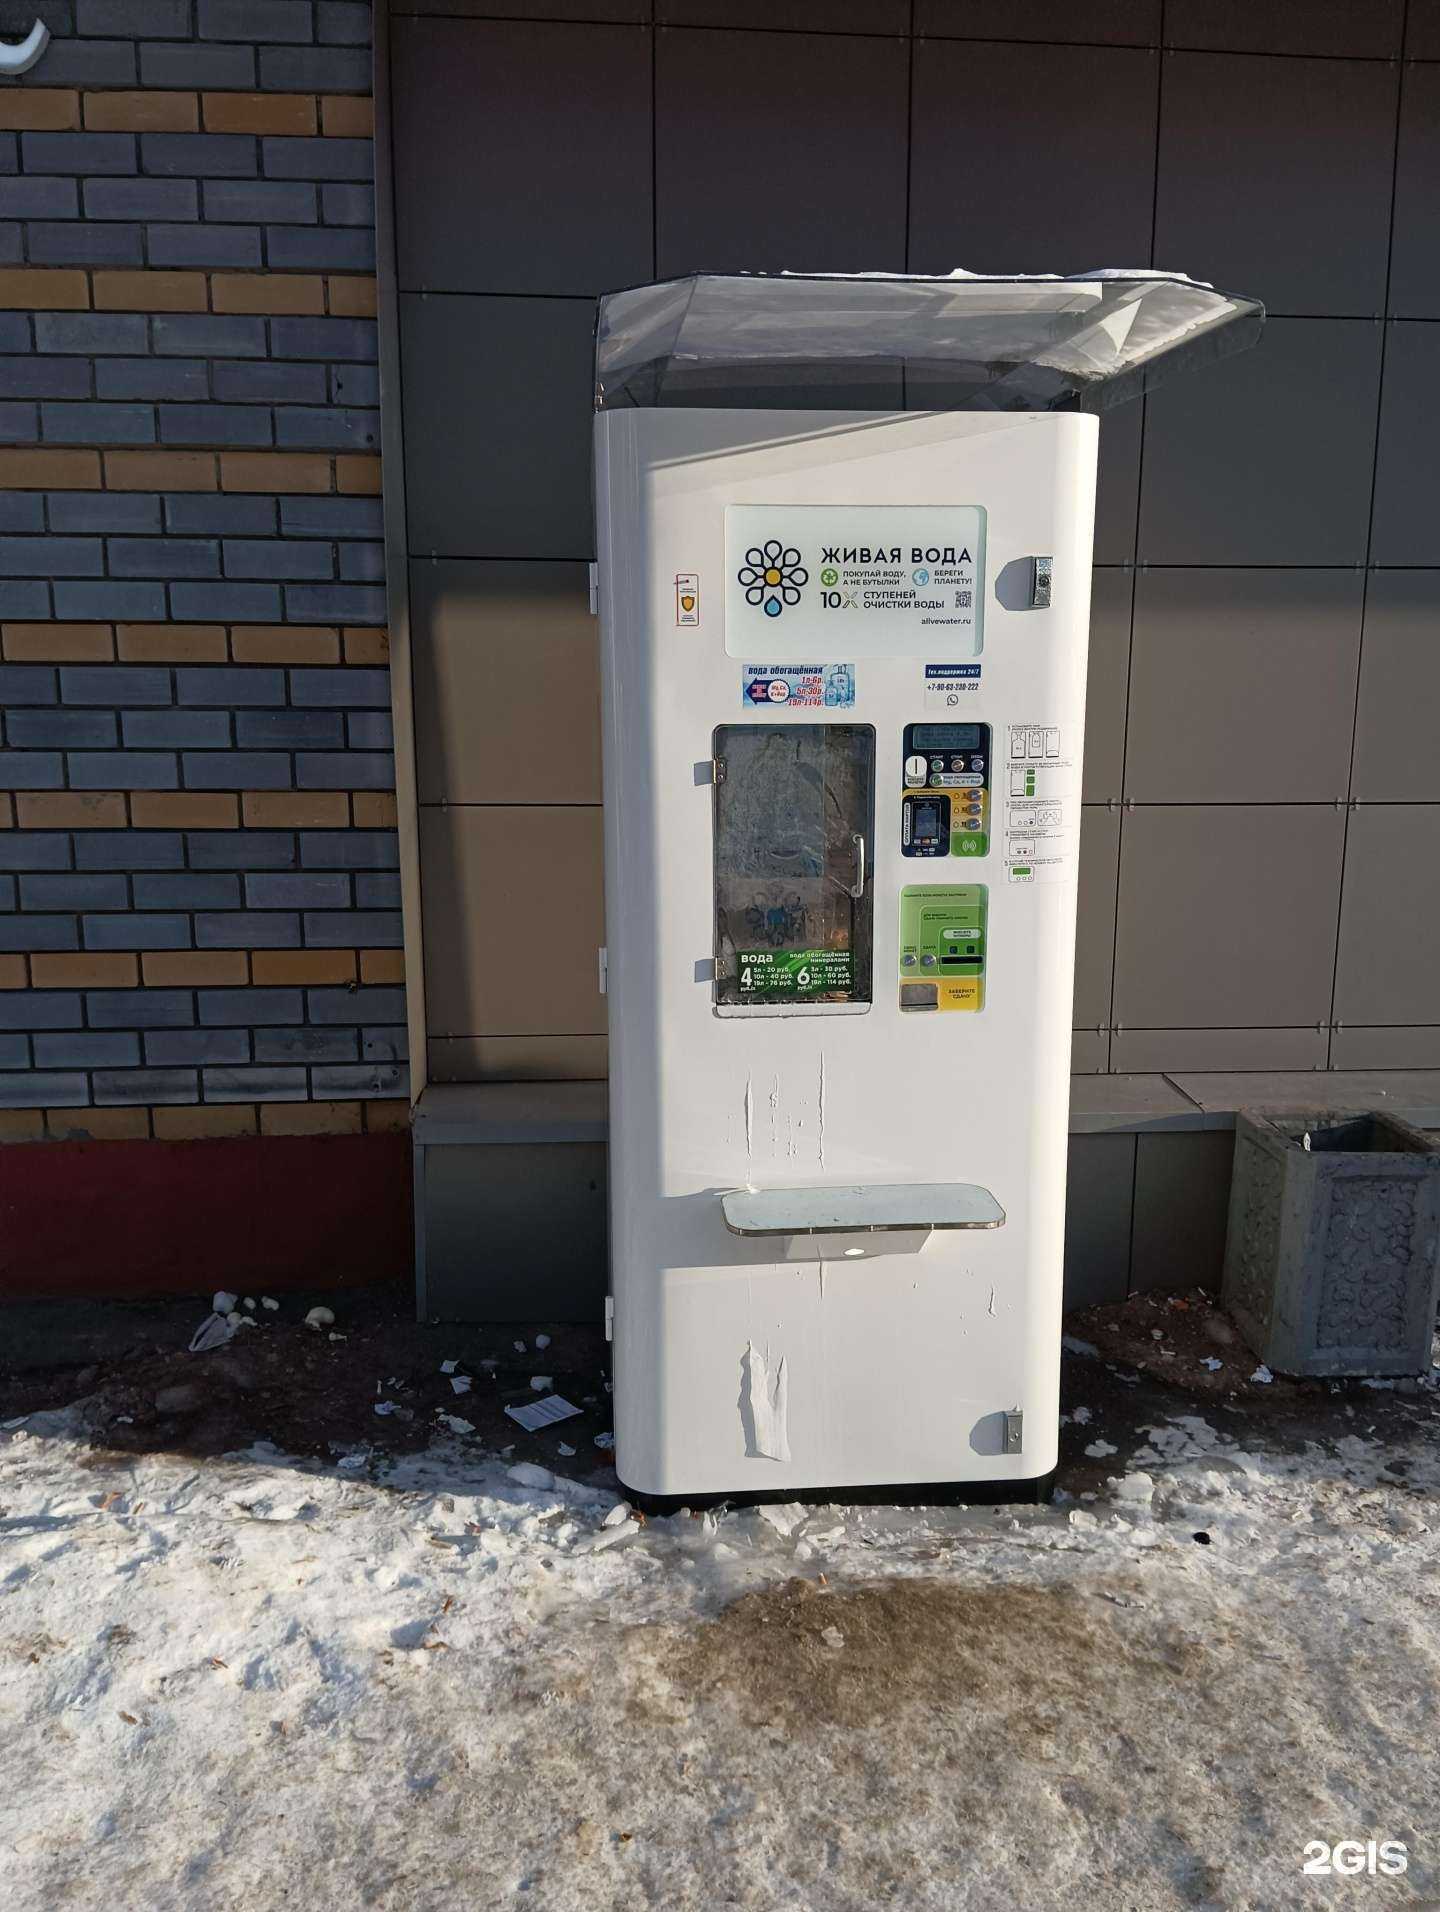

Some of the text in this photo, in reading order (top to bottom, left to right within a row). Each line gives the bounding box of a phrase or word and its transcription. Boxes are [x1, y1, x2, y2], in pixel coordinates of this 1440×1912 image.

[821, 547, 972, 566] ЖИВАЯ ВОДА
[843, 570, 907, 579] ПОКУПАЙ ВОДУ,
[863, 589, 916, 599] СТУПЕНЕЙ
[863, 600, 945, 610] ОЧИСТКИ ВОДЫ
[921, 617, 971, 625] alivewater.ru
[748, 665, 823, 677] вода обогащённая
[741, 953, 773, 965] вода
[740, 967, 753, 986] 4
[797, 966, 810, 985] 6
